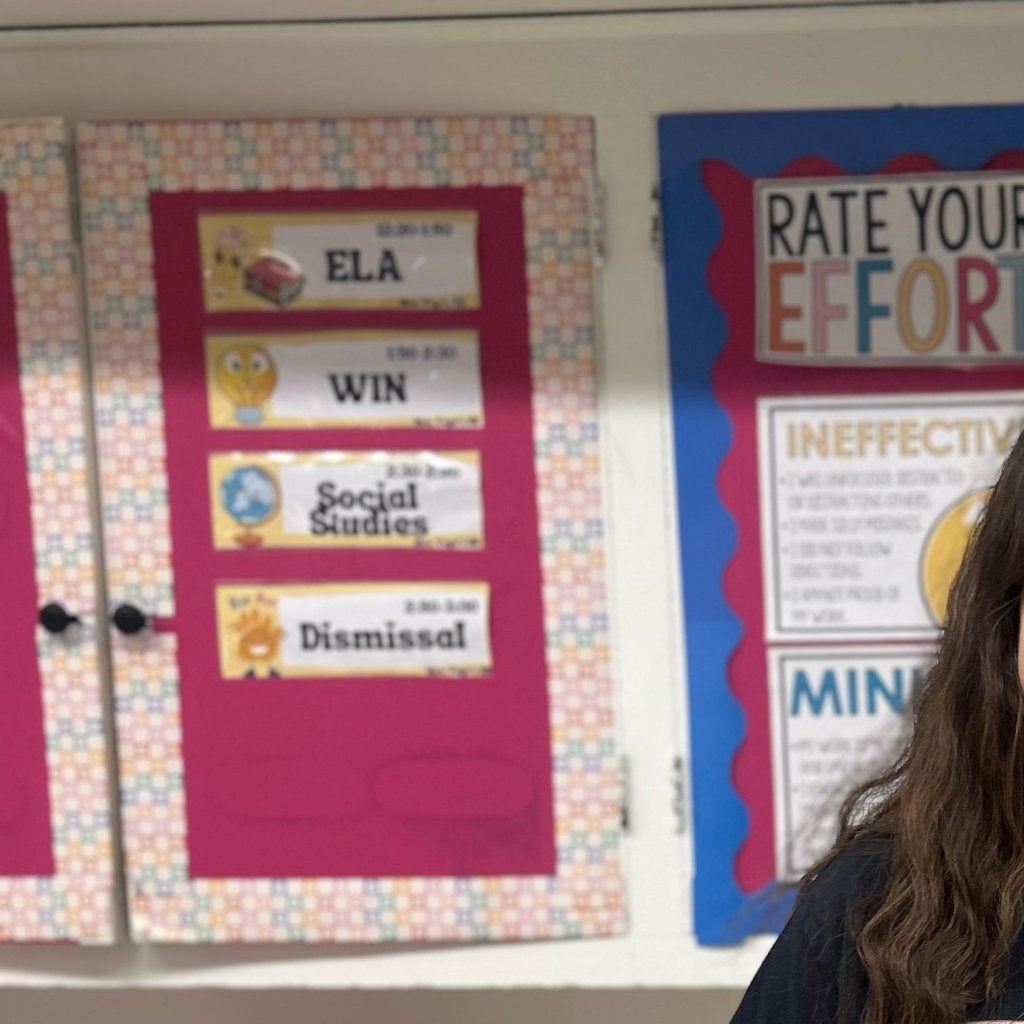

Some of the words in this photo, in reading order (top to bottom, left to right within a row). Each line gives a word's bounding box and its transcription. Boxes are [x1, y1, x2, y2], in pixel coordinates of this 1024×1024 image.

[768, 189, 890, 256] RATE
[325, 250, 402, 283] ELA
[328, 372, 408, 403] WIN
[785, 416, 1024, 460] INEFFECTIV
[317, 481, 418, 512] Social
[309, 504, 429, 537] Studies
[299, 621, 467, 651] Dismissal
